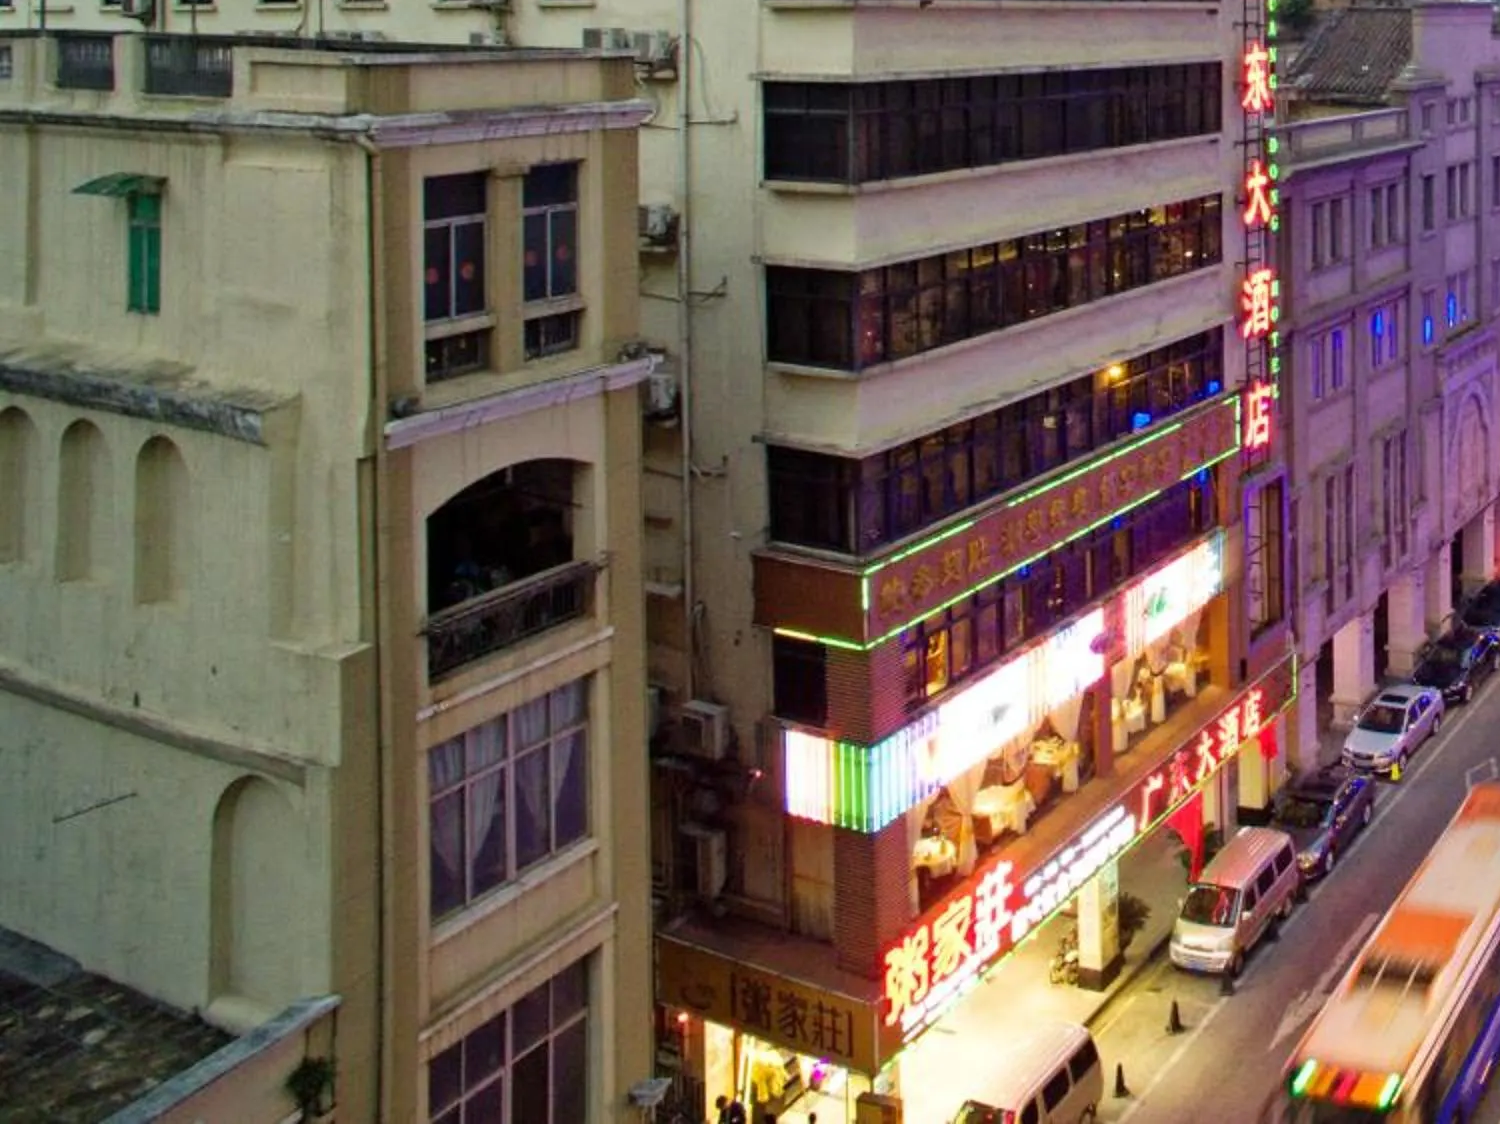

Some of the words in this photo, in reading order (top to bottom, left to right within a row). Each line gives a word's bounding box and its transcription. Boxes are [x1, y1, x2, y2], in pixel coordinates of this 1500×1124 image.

[1268, 137, 1279, 231] DONG
[1271, 279, 1280, 399] HOTEL
[1140, 689, 1263, 832] 广东大酒店
